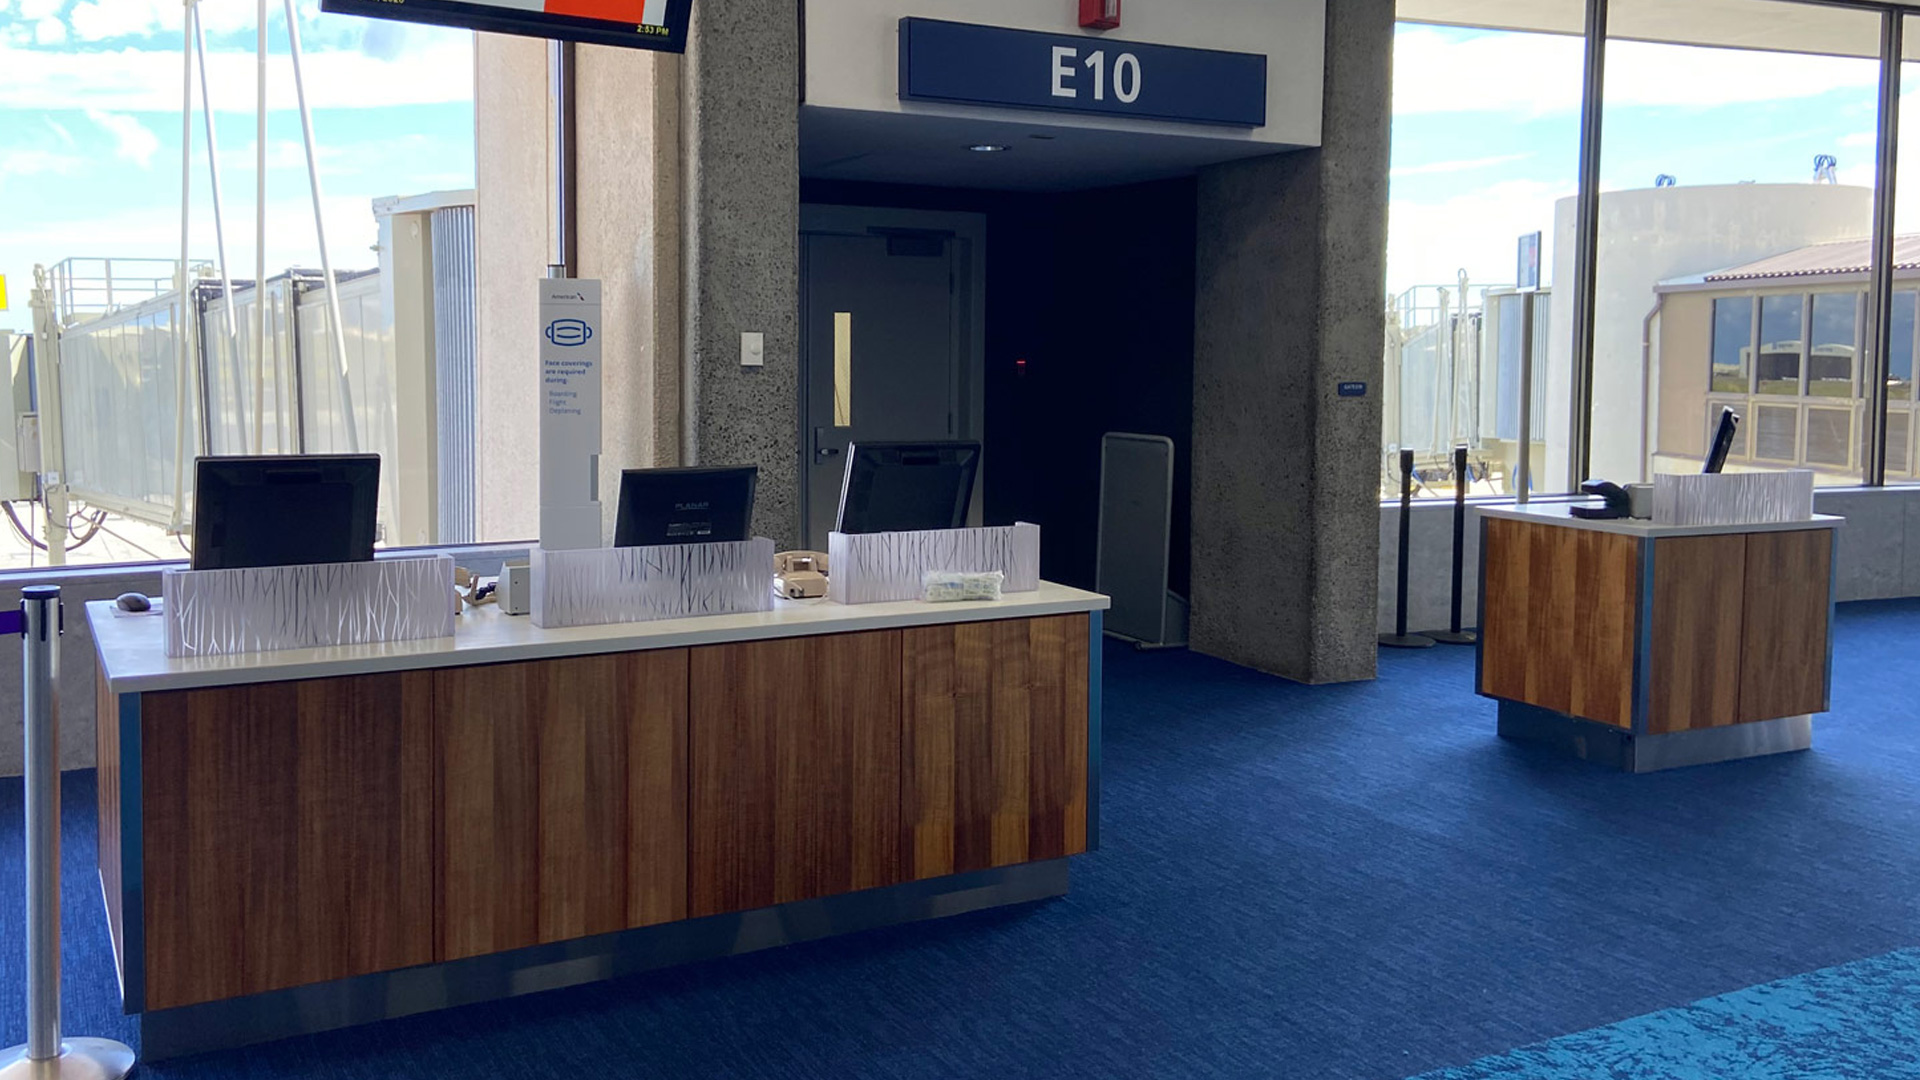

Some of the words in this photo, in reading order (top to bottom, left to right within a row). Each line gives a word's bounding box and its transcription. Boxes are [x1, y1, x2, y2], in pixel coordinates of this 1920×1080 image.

[636, 24, 654, 34] 2:53
[656, 26, 669, 36] PM
[1051, 45, 1142, 104] E10
